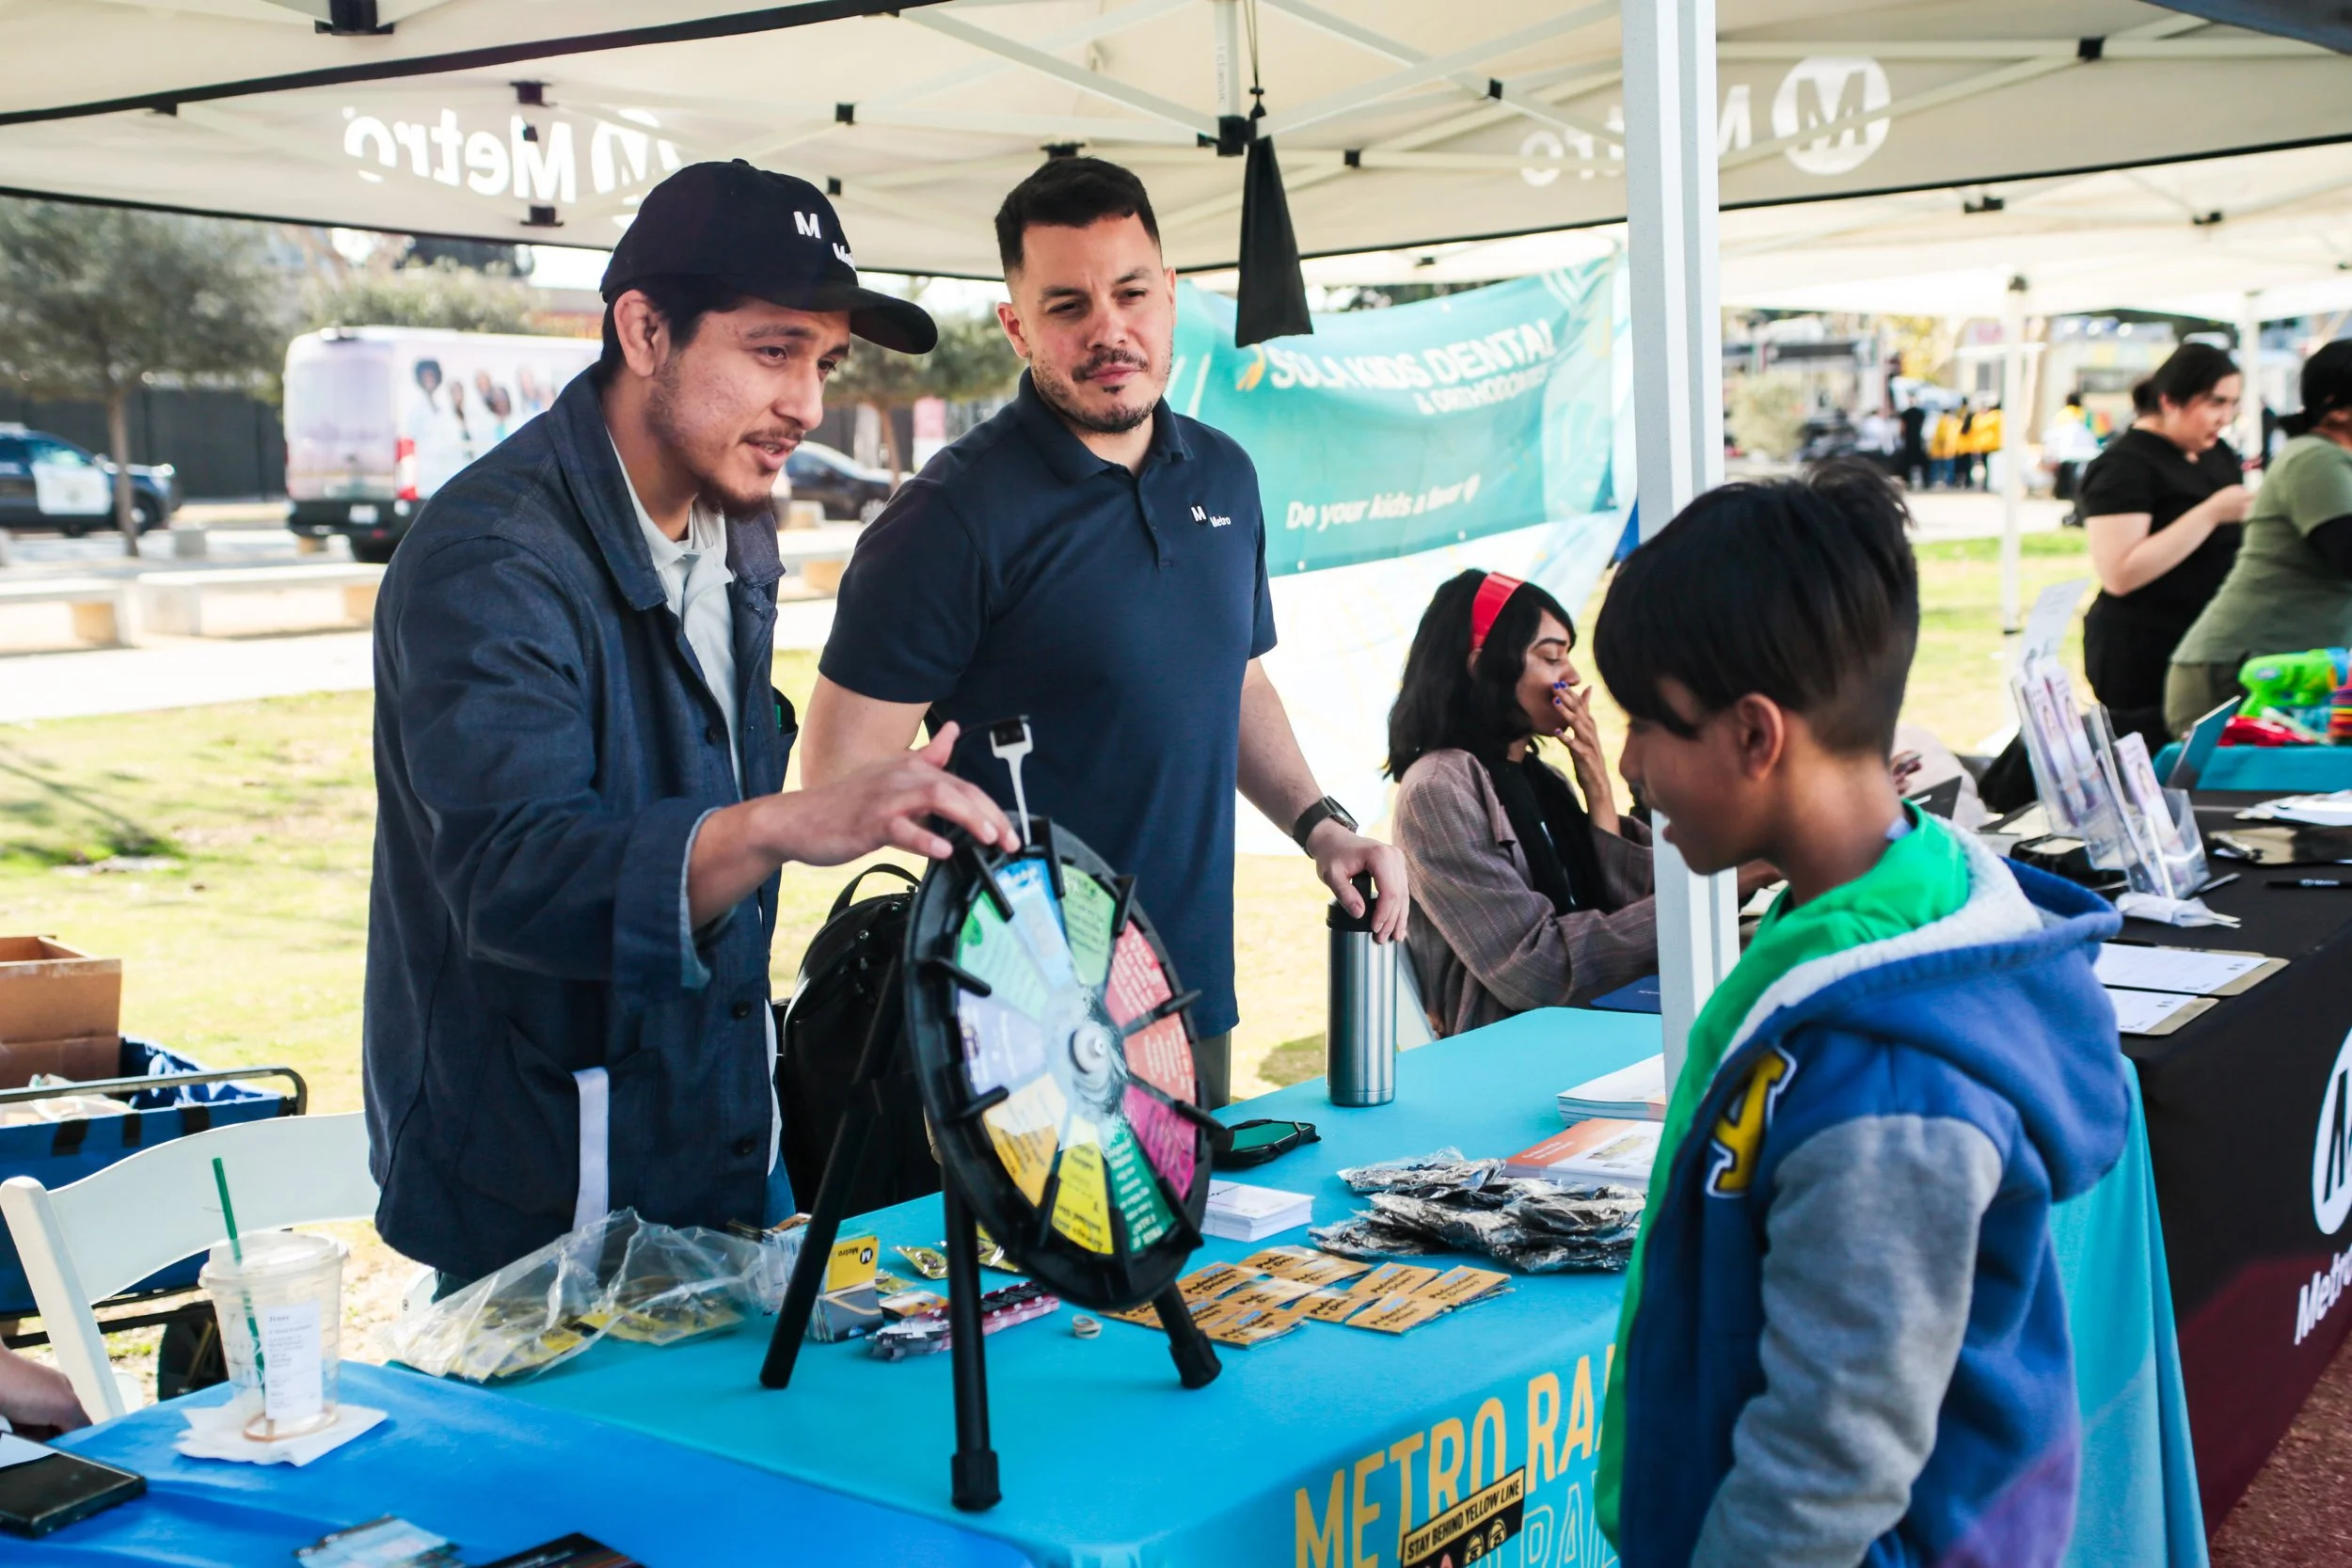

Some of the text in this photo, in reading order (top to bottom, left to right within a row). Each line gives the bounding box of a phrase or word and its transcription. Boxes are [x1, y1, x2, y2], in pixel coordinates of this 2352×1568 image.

[793, 211, 821, 239] M
[1343, 354, 1433, 389] KIDS
[1190, 505, 1207, 522] M
[1209, 515, 1232, 528] Metro
[1286, 500, 1314, 530] Do
[1317, 500, 1369, 533] your
[1369, 491, 1414, 519] kids
[837, 1246, 859, 1258] Metro
[1295, 1396, 1509, 1568] METRO
[1407, 1532, 1431, 1560] STAY
[1431, 1511, 1465, 1546] BEHIND
[1465, 1489, 1500, 1526] YELLOW
[1501, 1479, 1520, 1504] LINE
